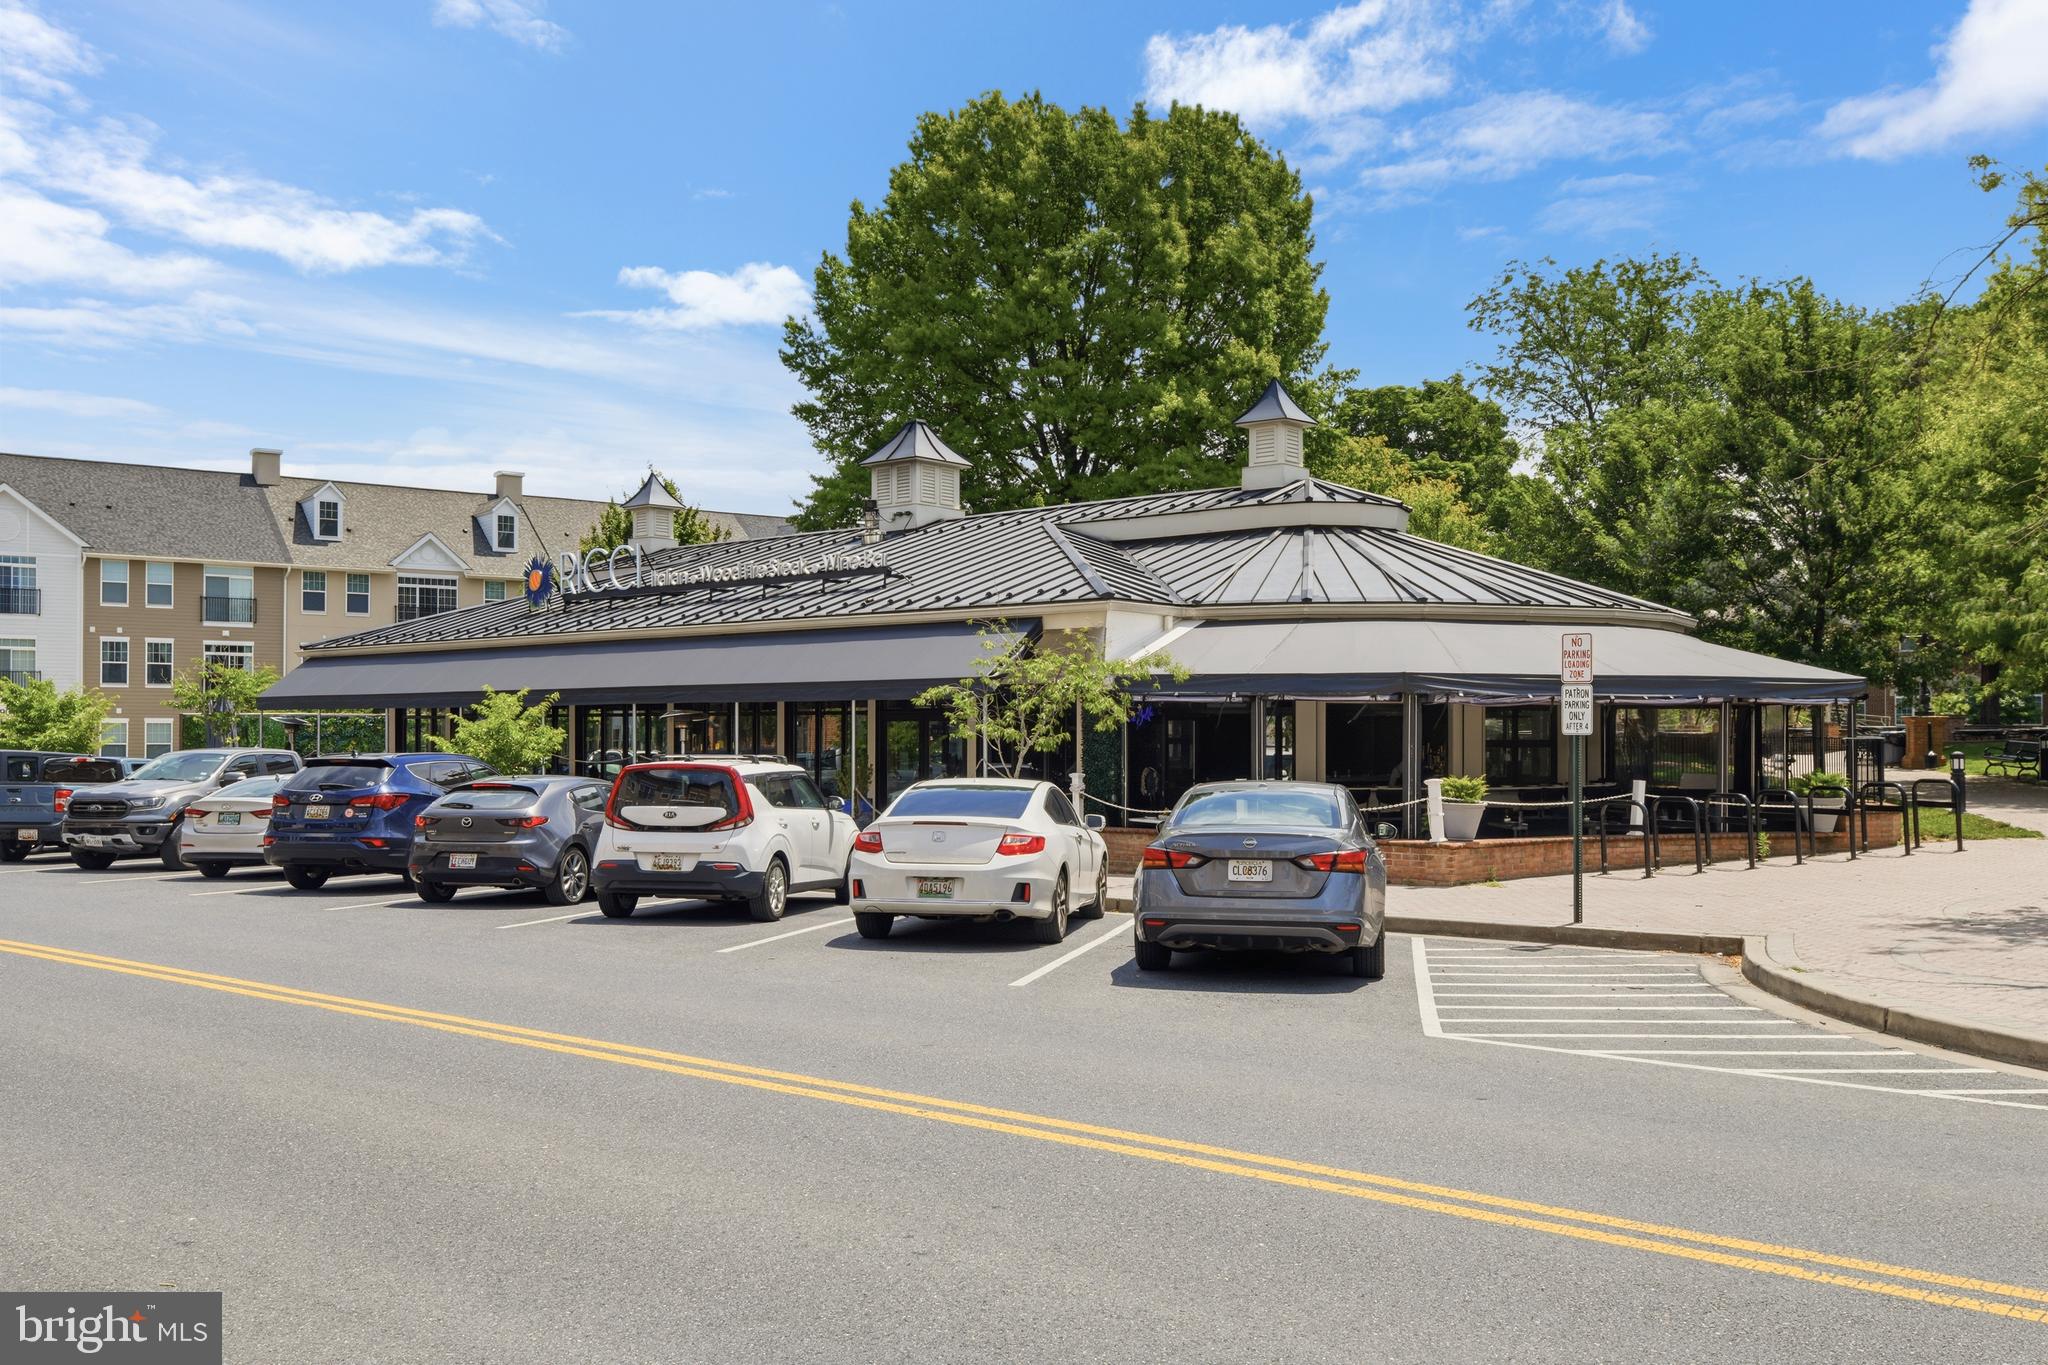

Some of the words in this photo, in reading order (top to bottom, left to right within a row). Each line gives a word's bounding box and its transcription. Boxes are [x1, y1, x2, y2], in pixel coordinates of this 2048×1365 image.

[560, 543, 641, 595] RICCI
[651, 567, 688, 587] Italian
[701, 562, 740, 583] Wood
[744, 561, 767, 580] Fire
[769, 556, 810, 577] Steak
[821, 552, 860, 571] Wine
[863, 550, 888, 569] Bar
[1571, 638, 1583, 647] NO
[1563, 650, 1591, 659] PARKING
[1564, 660, 1590, 668] LOADING
[1569, 670, 1585, 678] ZONE
[1564, 689, 1590, 699] PATRON
[1564, 700, 1590, 709] PARKING
[1568, 711, 1586, 720] ONLY
[1566, 722, 1584, 730] AFTER
[1584, 722, 1589, 730] 4
